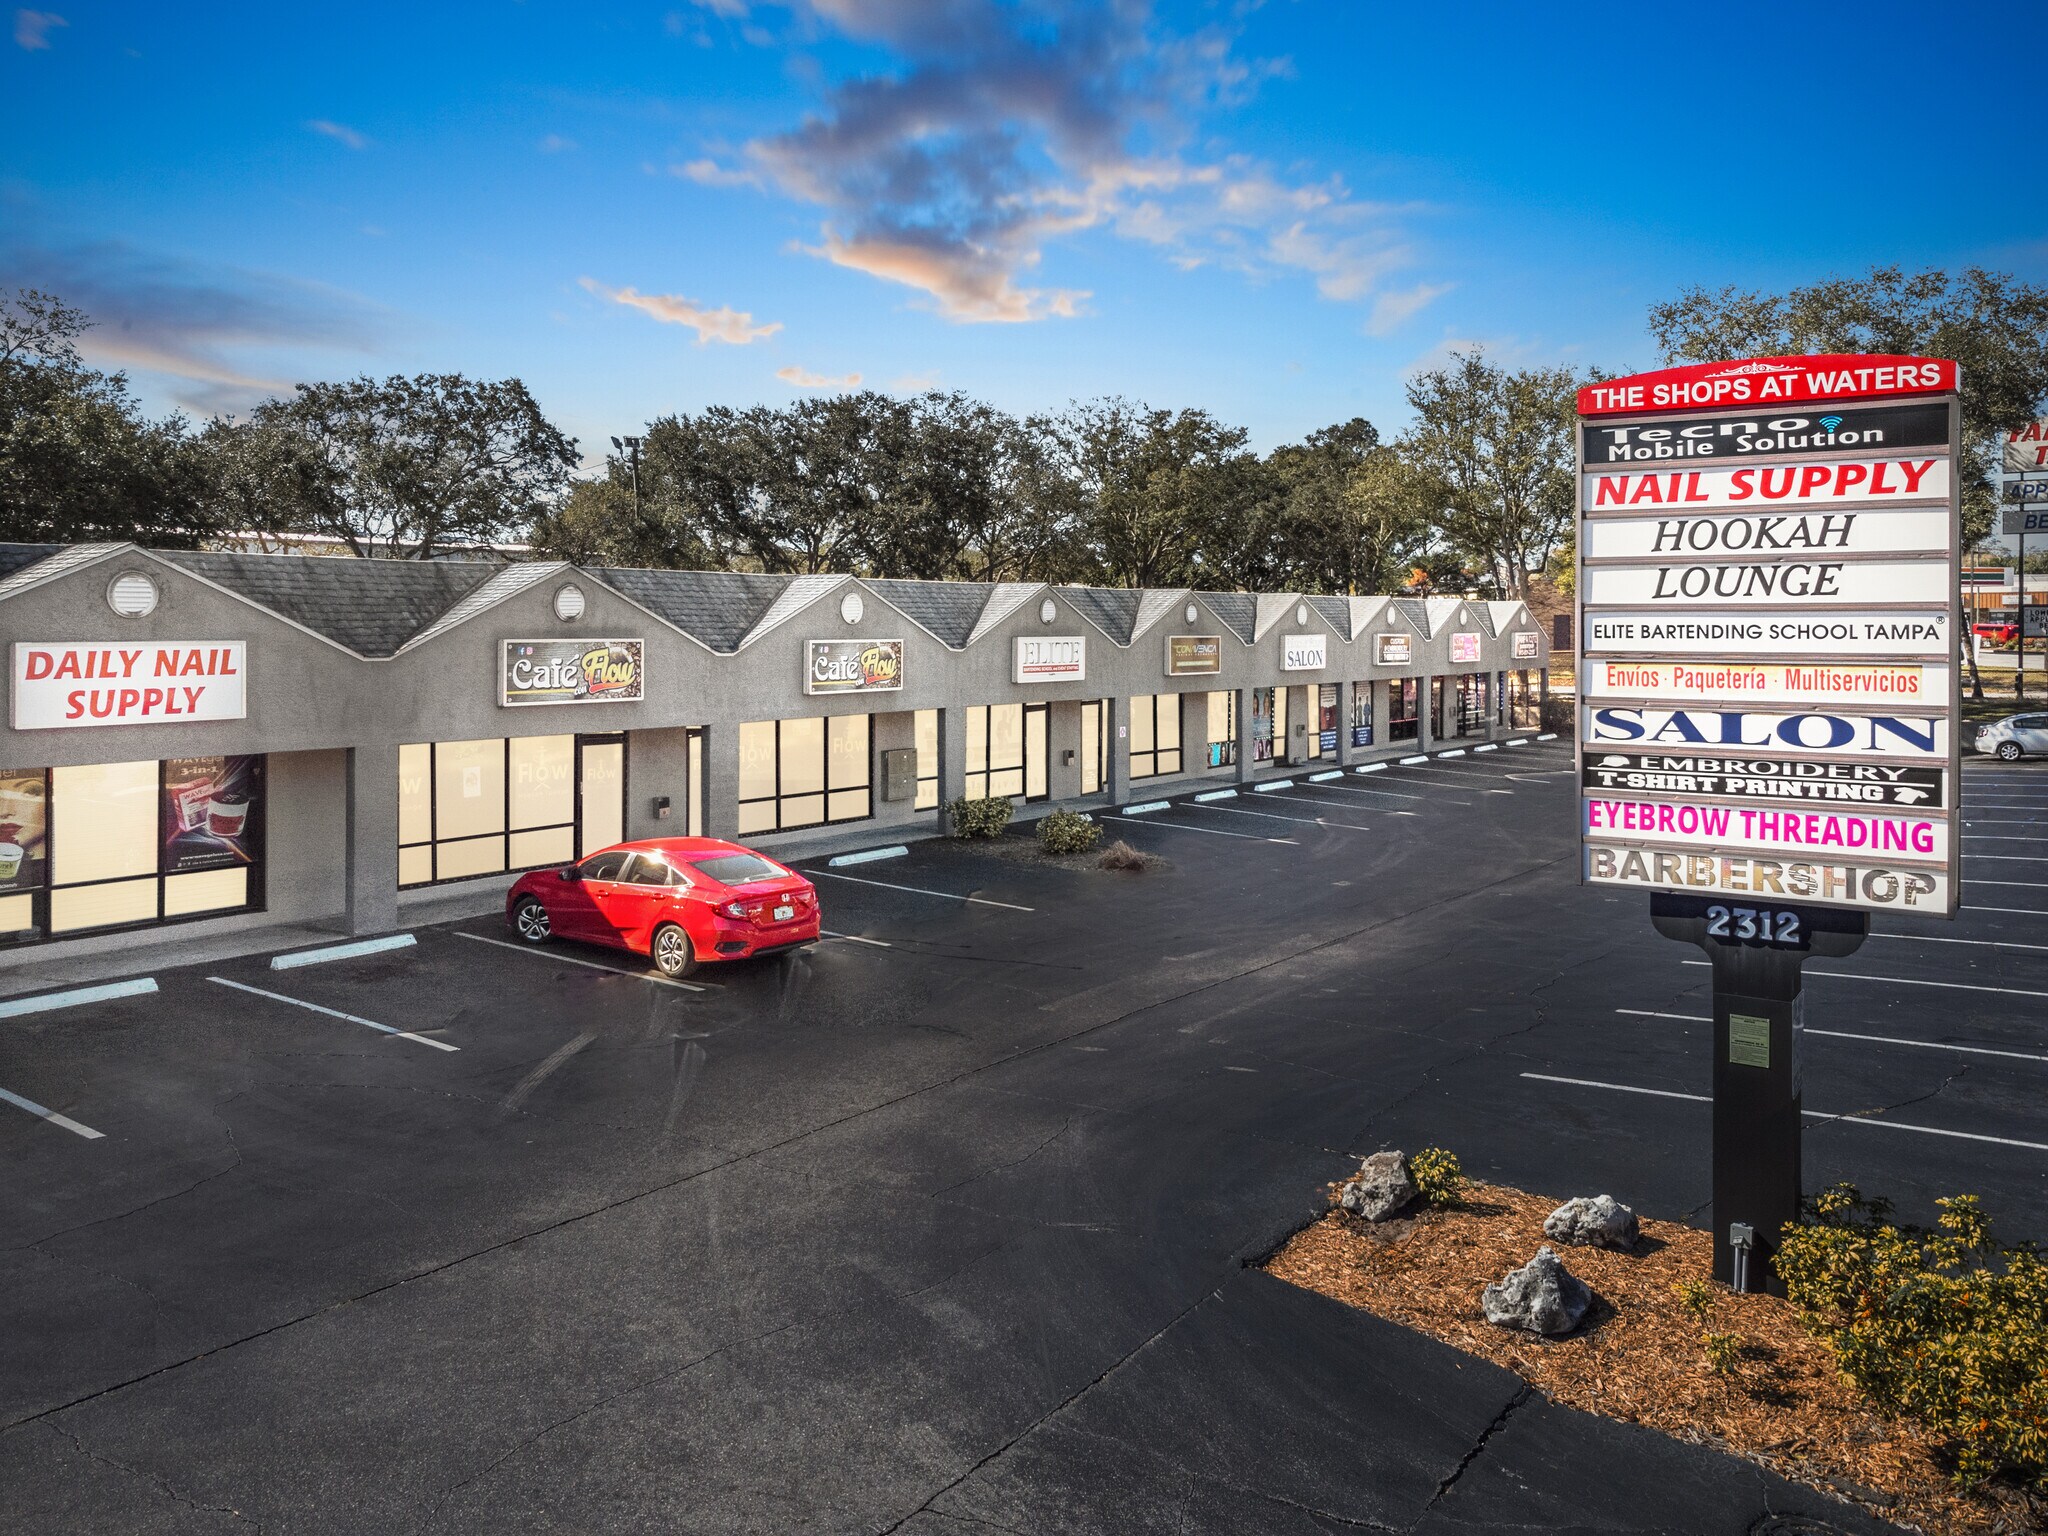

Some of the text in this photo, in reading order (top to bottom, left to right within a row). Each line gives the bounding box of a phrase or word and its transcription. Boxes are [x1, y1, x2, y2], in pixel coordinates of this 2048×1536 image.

[1591, 363, 1941, 409] THE SHOPS AT WATERS
[1601, 418, 1810, 444] Tecno
[1608, 429, 1884, 462] Mobile Solution
[2009, 423, 2048, 442] FA
[1595, 459, 1937, 506] NAIL SUPPLY
[1651, 514, 1857, 553] HOOKAH
[1652, 563, 1844, 599] LOUNGE
[1594, 624, 1634, 639] ELITE
[1641, 624, 1763, 639] BARTENDING
[1769, 624, 1858, 640] SCHOOL
[25, 648, 237, 680] DAILY NAIL
[815, 652, 860, 681] Café
[861, 646, 898, 686] Flow
[1023, 641, 1080, 664] ELITE
[1287, 650, 1323, 667] SALON
[512, 653, 580, 689] Café
[581, 647, 636, 694] Flow
[1607, 665, 1918, 693] Envíos Paquetería Multiservicios
[65, 686, 206, 719] SUPPLY
[1594, 708, 1945, 752] SALON
[181, 766, 219, 776] 3-in-1
[1640, 756, 1908, 781] EMBROIDERY
[1597, 771, 1885, 802] T-SHIRT PRINTING
[1588, 800, 1934, 853] EYEBROW THREADING
[1589, 848, 1937, 905] BARBERSHOP
[1706, 905, 1801, 943] 2312
